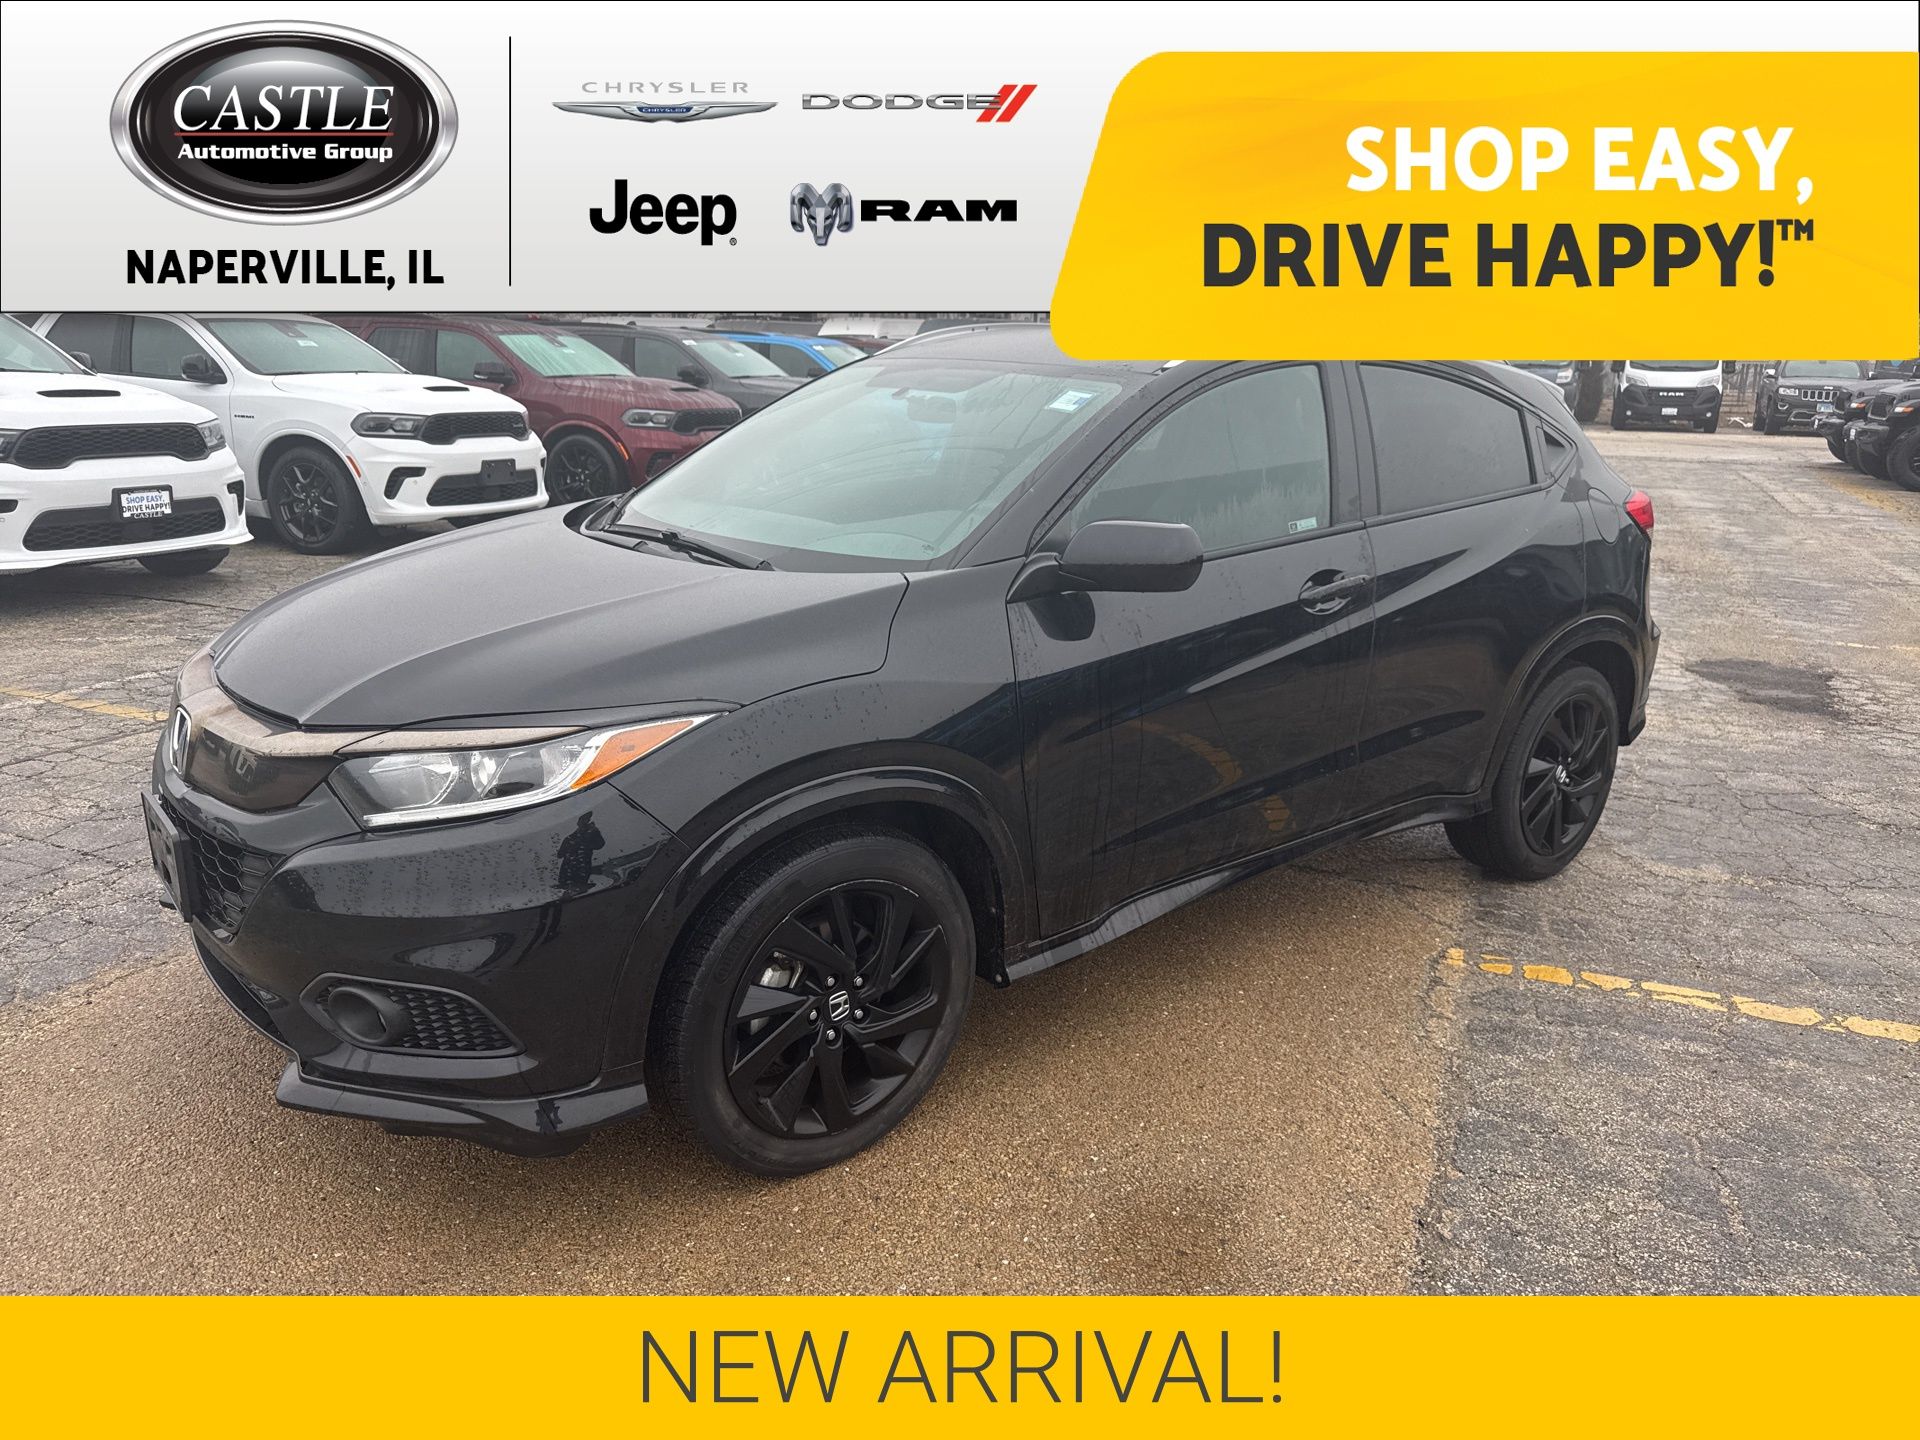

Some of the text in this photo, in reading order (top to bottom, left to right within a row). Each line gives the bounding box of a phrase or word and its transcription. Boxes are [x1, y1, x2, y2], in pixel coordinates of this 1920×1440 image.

[126, 496, 145, 505] SHOP
[122, 502, 171, 513] DRIVE HAPPY!
[134, 511, 163, 519] CASTLE
